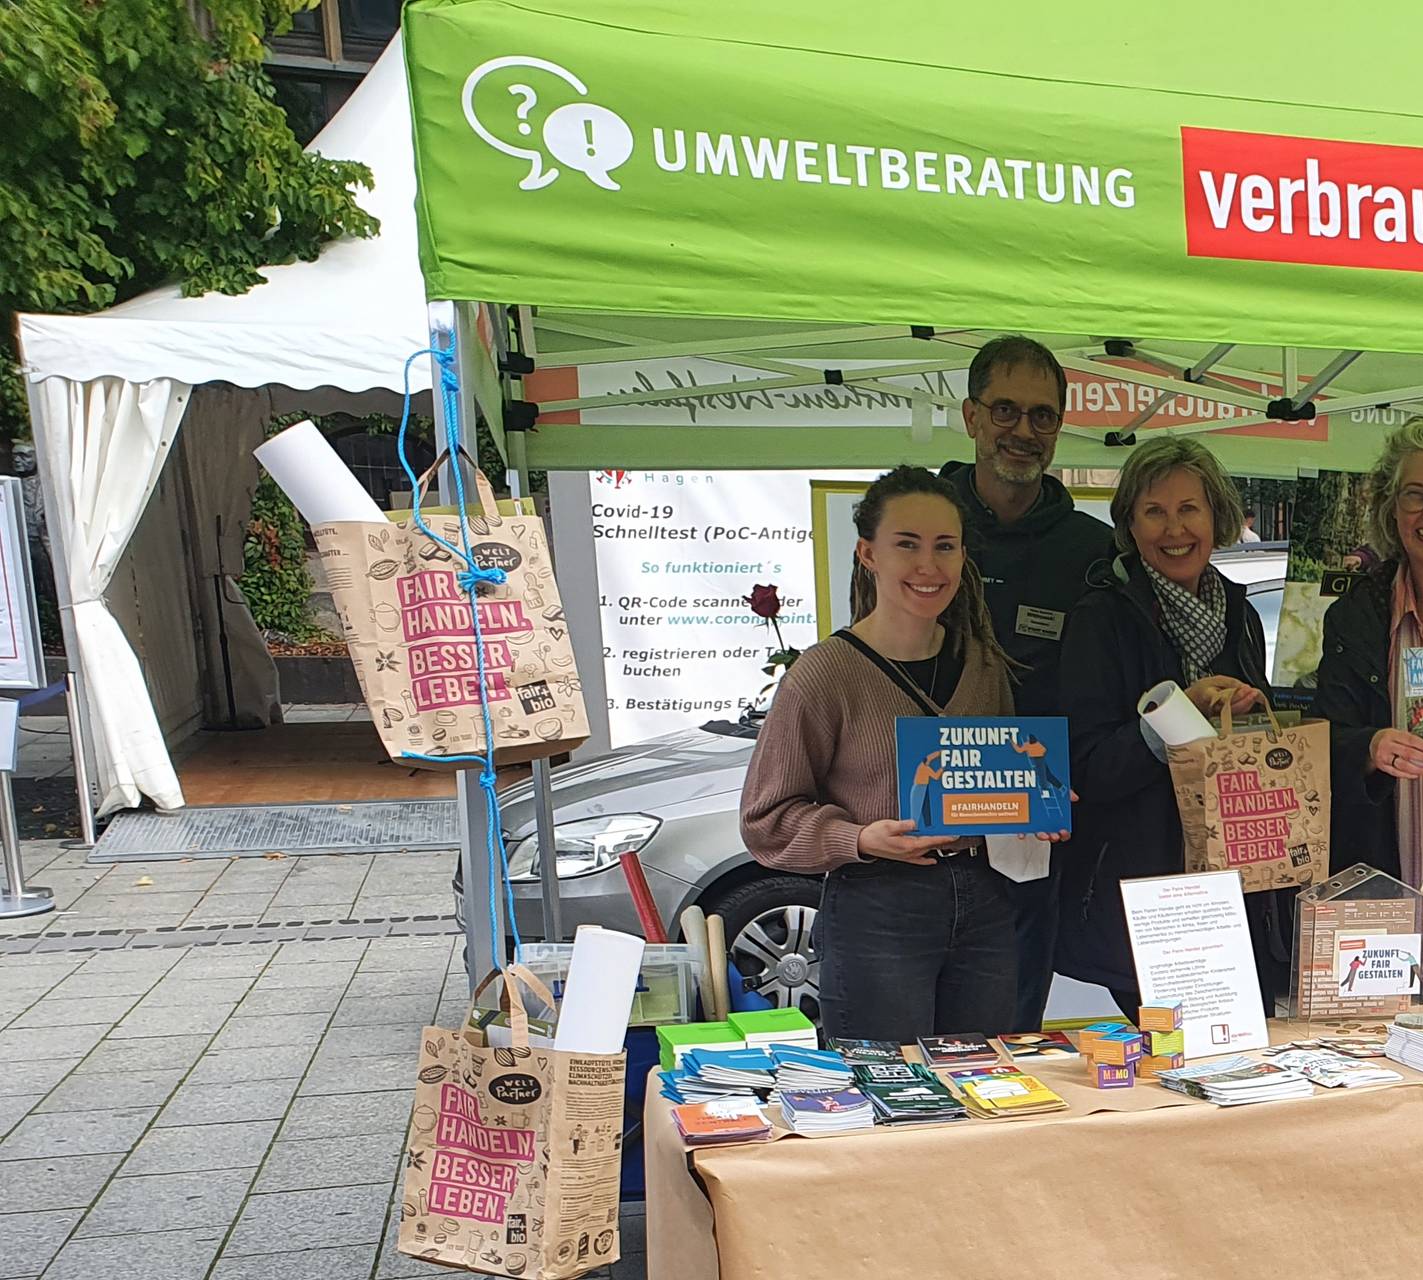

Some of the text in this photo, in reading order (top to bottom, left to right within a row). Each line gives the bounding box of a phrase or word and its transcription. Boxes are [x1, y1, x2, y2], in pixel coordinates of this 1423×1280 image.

[652, 126, 1137, 210] UMWELTBERATUNG
[644, 473, 713, 486] Hagen
[592, 504, 673, 519] Covid-19
[593, 525, 814, 543] Schnelltest (PoC-Antige
[641, 562, 660, 573] So
[403, 573, 451, 604] FAIR
[600, 596, 803, 610] 1. QR-Code scanne der
[407, 603, 526, 636] HANDELN.
[619, 614, 663, 625] unter
[412, 642, 506, 674] BESSER
[603, 648, 616, 658] 2.
[622, 647, 716, 663] registrieren
[723, 648, 759, 658] oder
[623, 664, 681, 677] buchen
[415, 677, 505, 708] LEBEN.
[532, 697, 553, 711] bio
[626, 698, 731, 713] Bestätigungs
[939, 727, 1019, 745] ZUKUNFT
[941, 750, 981, 767] FAIR
[942, 770, 1036, 789] GESTALTEN
[1221, 774, 1255, 795] FAIR
[951, 802, 1019, 811] #FAIRHANDELN
[1223, 791, 1297, 815] HANDELN.
[1226, 819, 1286, 841] BESSER
[1227, 840, 1284, 863] LEBEN.
[1297, 853, 1310, 865] bio
[1362, 949, 1400, 959] ZUKUNFT
[1371, 959, 1390, 969] FAIR
[1358, 970, 1403, 979] GESTALTEN
[444, 1089, 477, 1119] FAIR
[441, 1117, 534, 1157] HANDELN.
[435, 1155, 513, 1192] BESSER
[431, 1185, 503, 1221] LEBEN.
[510, 1231, 526, 1243] bio
